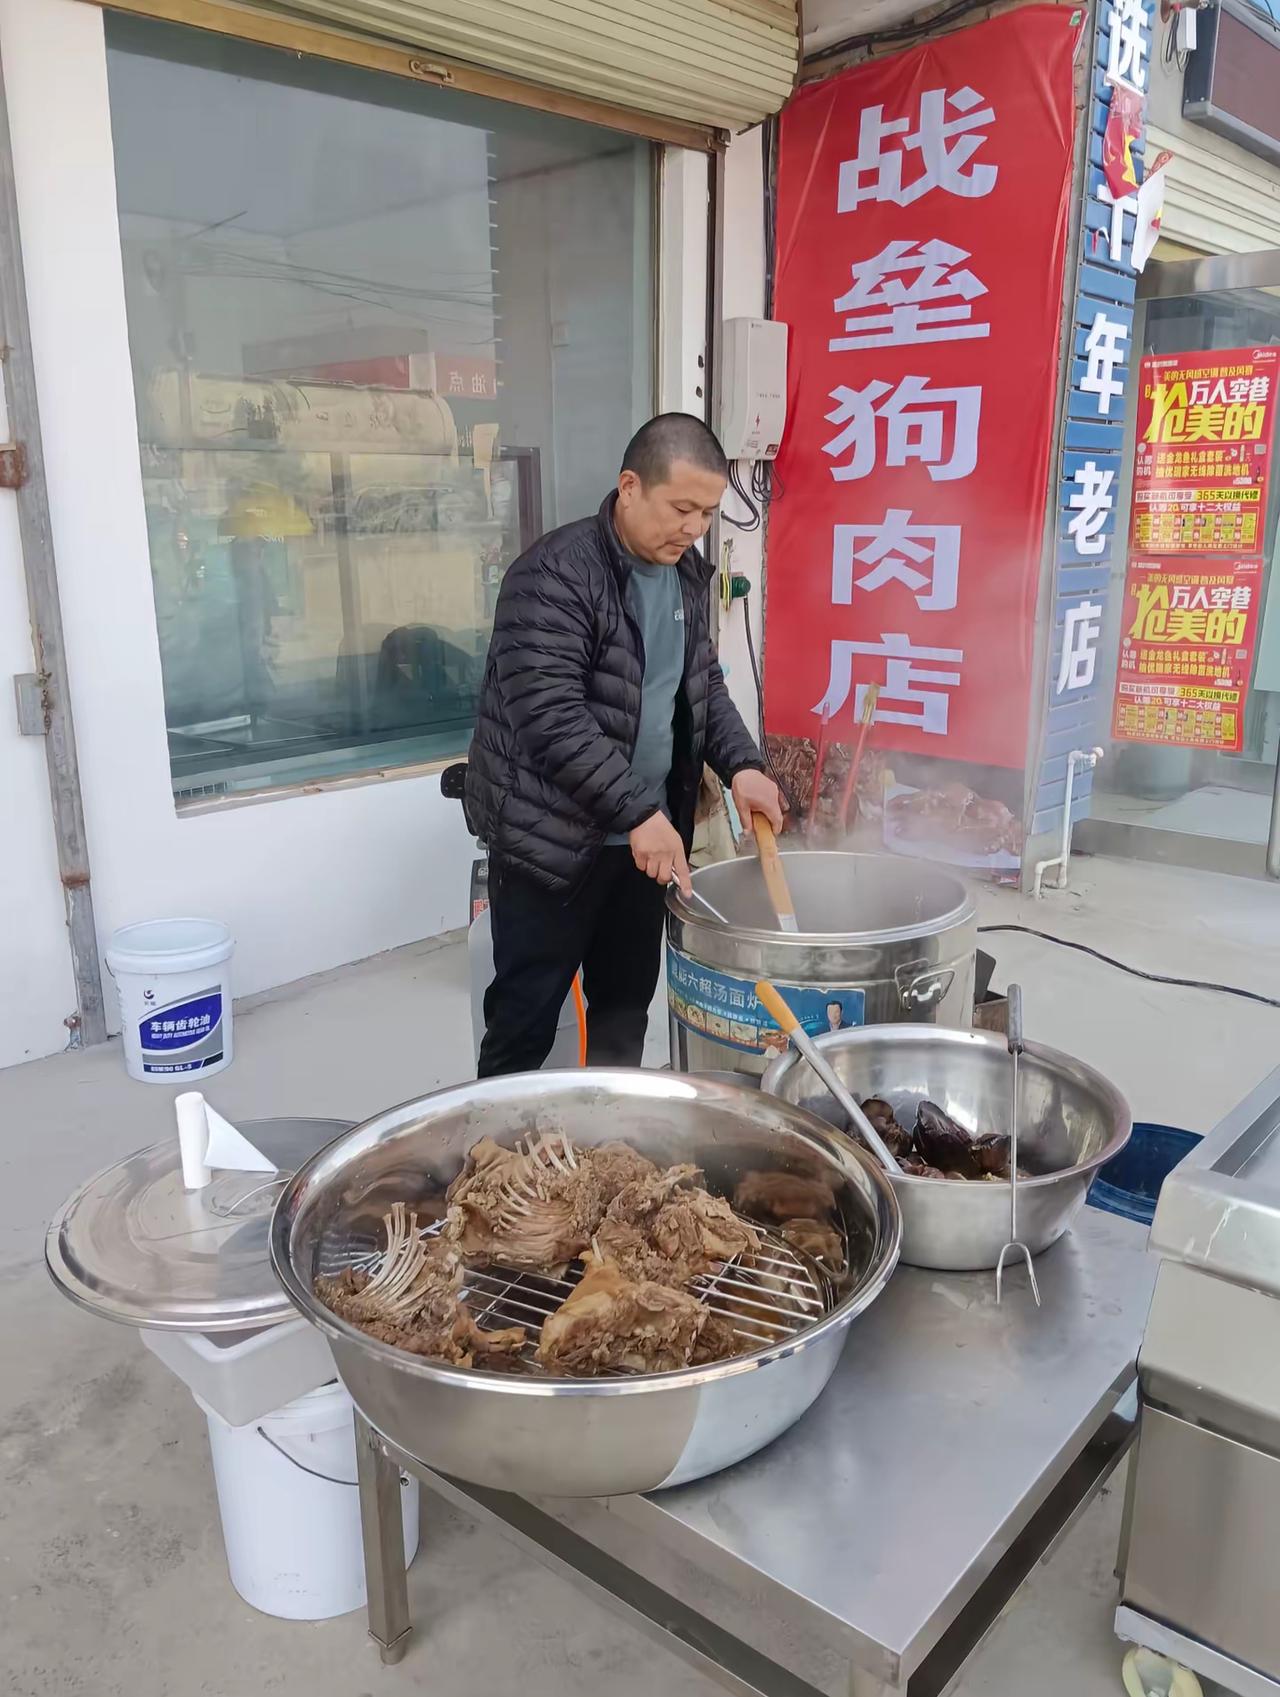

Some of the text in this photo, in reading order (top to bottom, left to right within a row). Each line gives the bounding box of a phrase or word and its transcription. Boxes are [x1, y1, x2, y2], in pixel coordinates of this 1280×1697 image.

[811, 85, 999, 737] 战垒狗肉店
[1142, 382, 1266, 443] 抢美的
[1189, 376, 1270, 405] 万人空巷
[1128, 584, 1247, 644] 抢美的
[1170, 586, 1251, 609] 万人空巷
[151, 1014, 211, 1032] 车辆齿轮油
